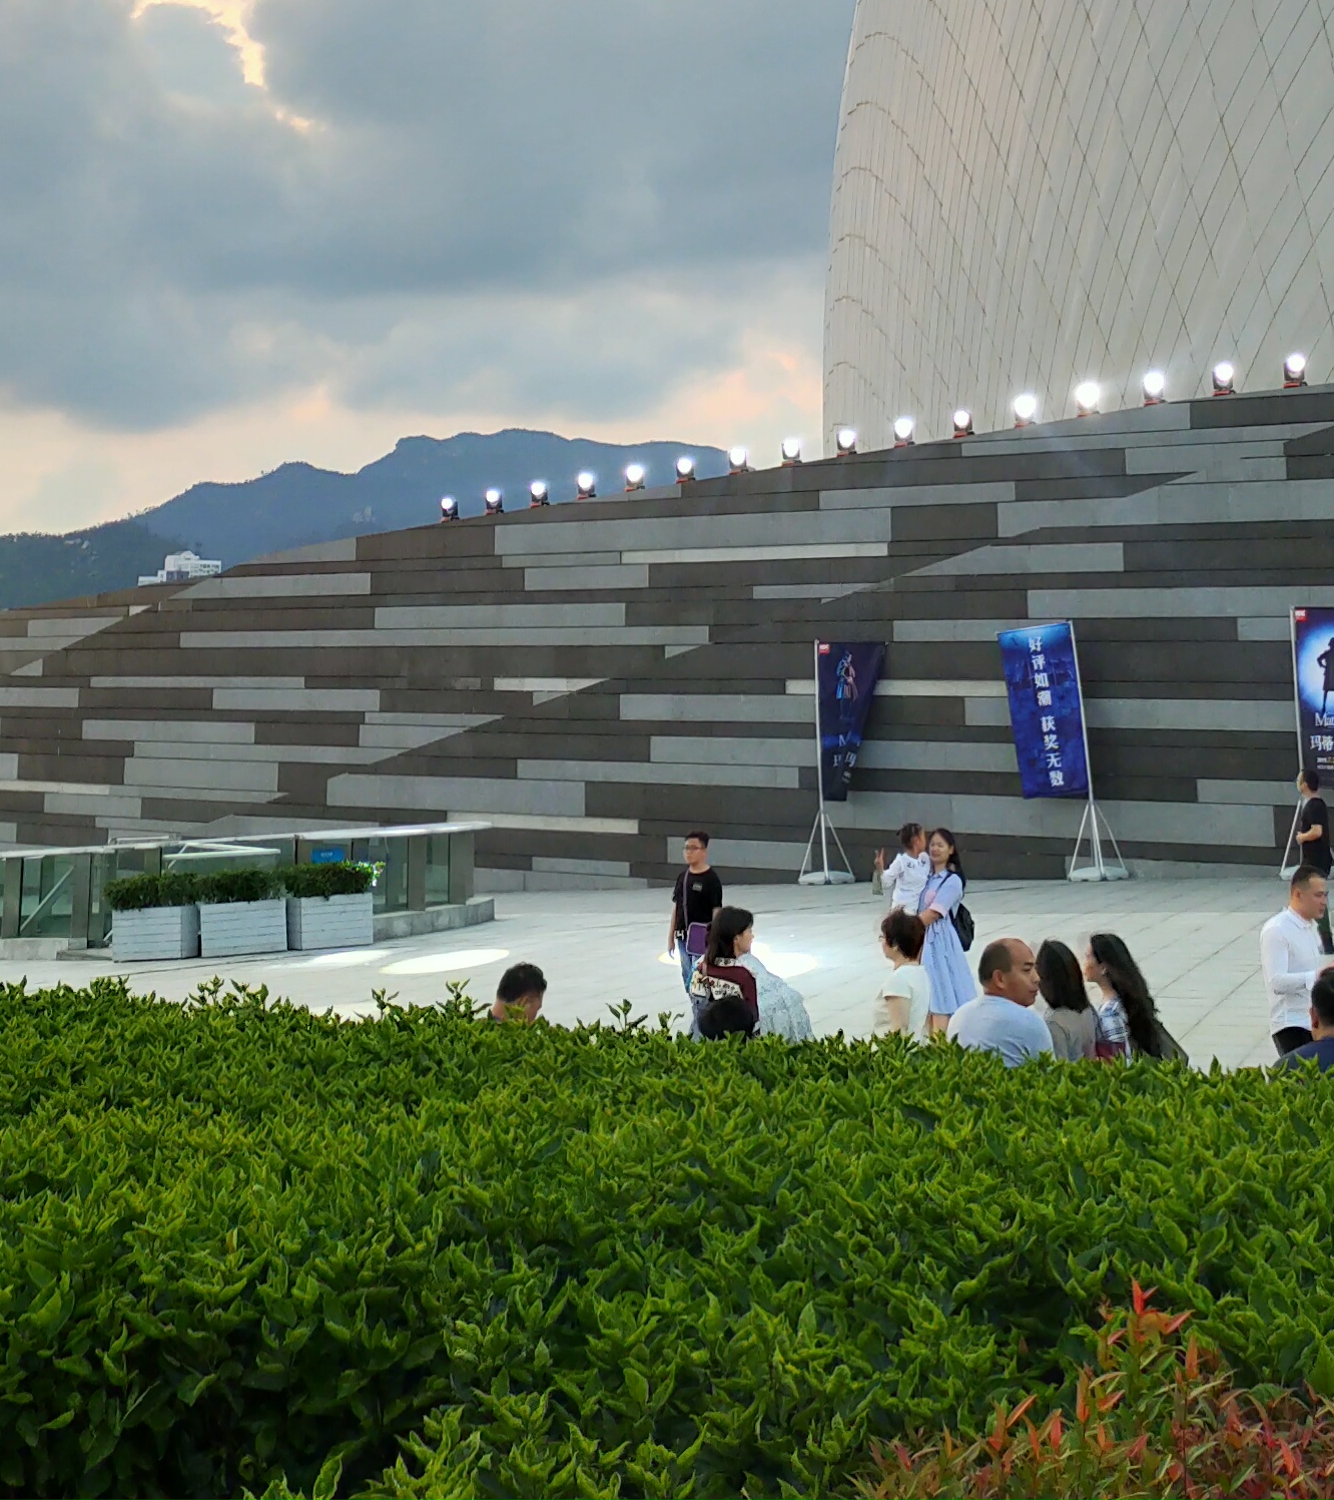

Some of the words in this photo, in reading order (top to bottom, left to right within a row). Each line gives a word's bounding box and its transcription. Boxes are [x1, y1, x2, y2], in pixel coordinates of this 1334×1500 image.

[1028, 636, 1052, 706] 好评如潮
[1039, 715, 1065, 788] 获奖无数
